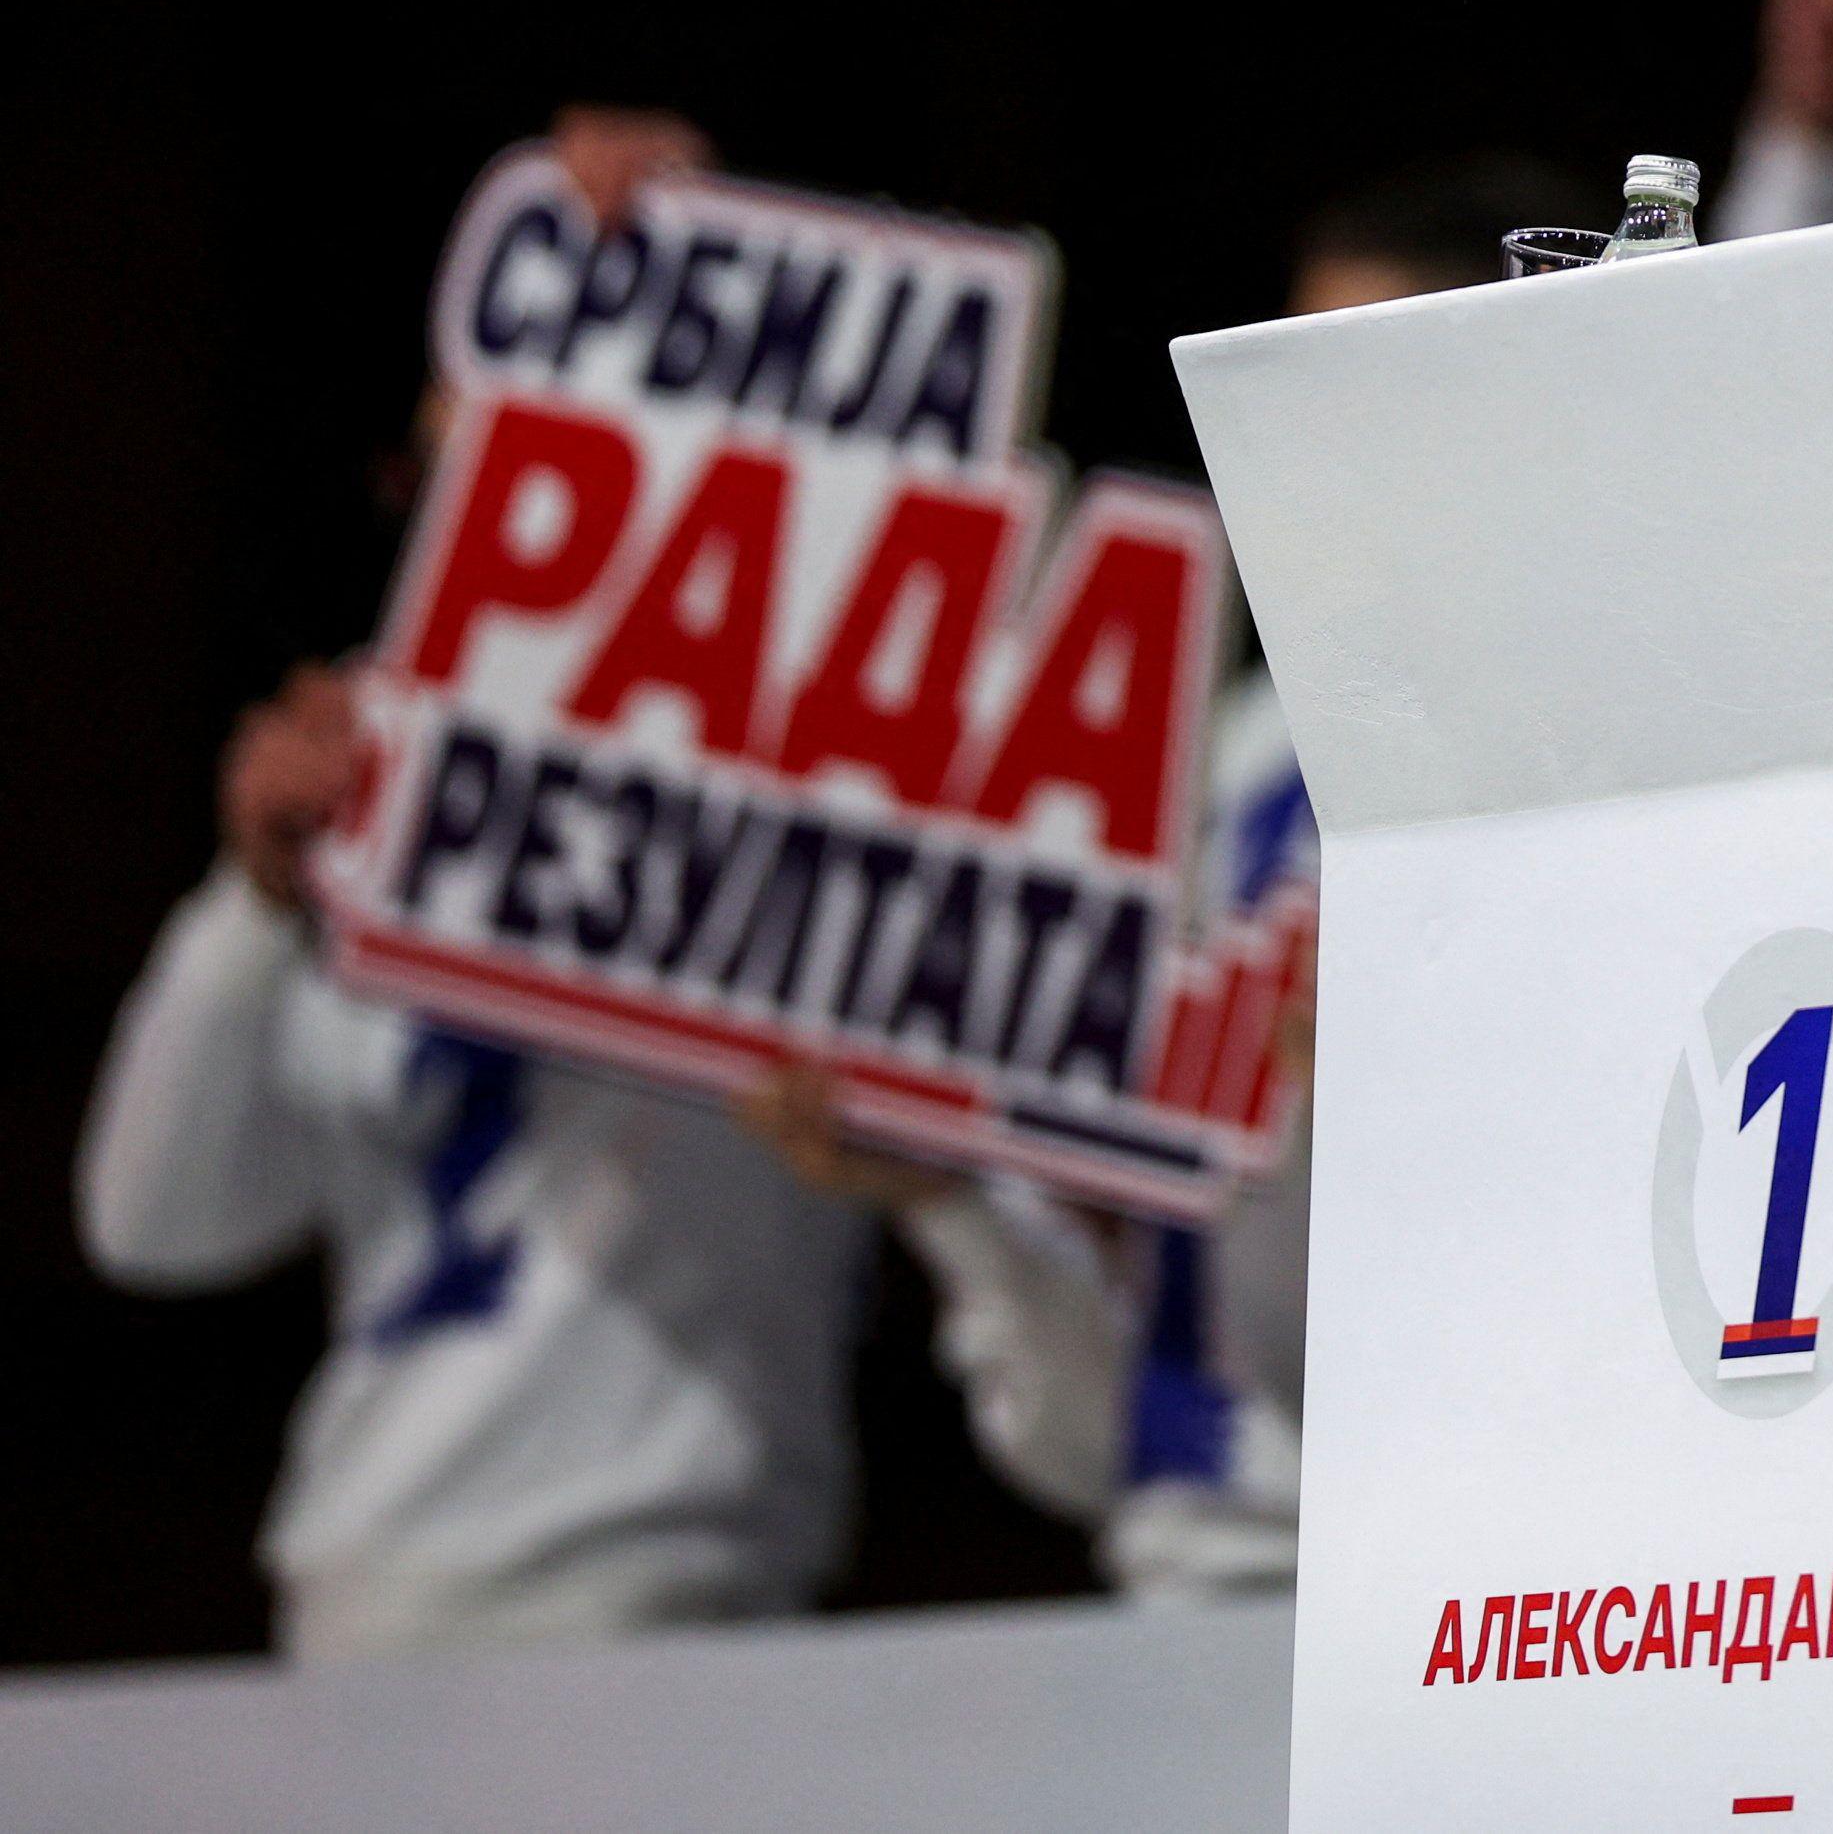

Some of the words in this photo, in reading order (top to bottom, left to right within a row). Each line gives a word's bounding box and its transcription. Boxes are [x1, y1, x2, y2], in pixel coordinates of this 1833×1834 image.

[470, 202, 1000, 458] СРБИЈА
[415, 398, 1195, 866] РАДА
[400, 724, 1160, 1108] РЕЗУЛТАТА
